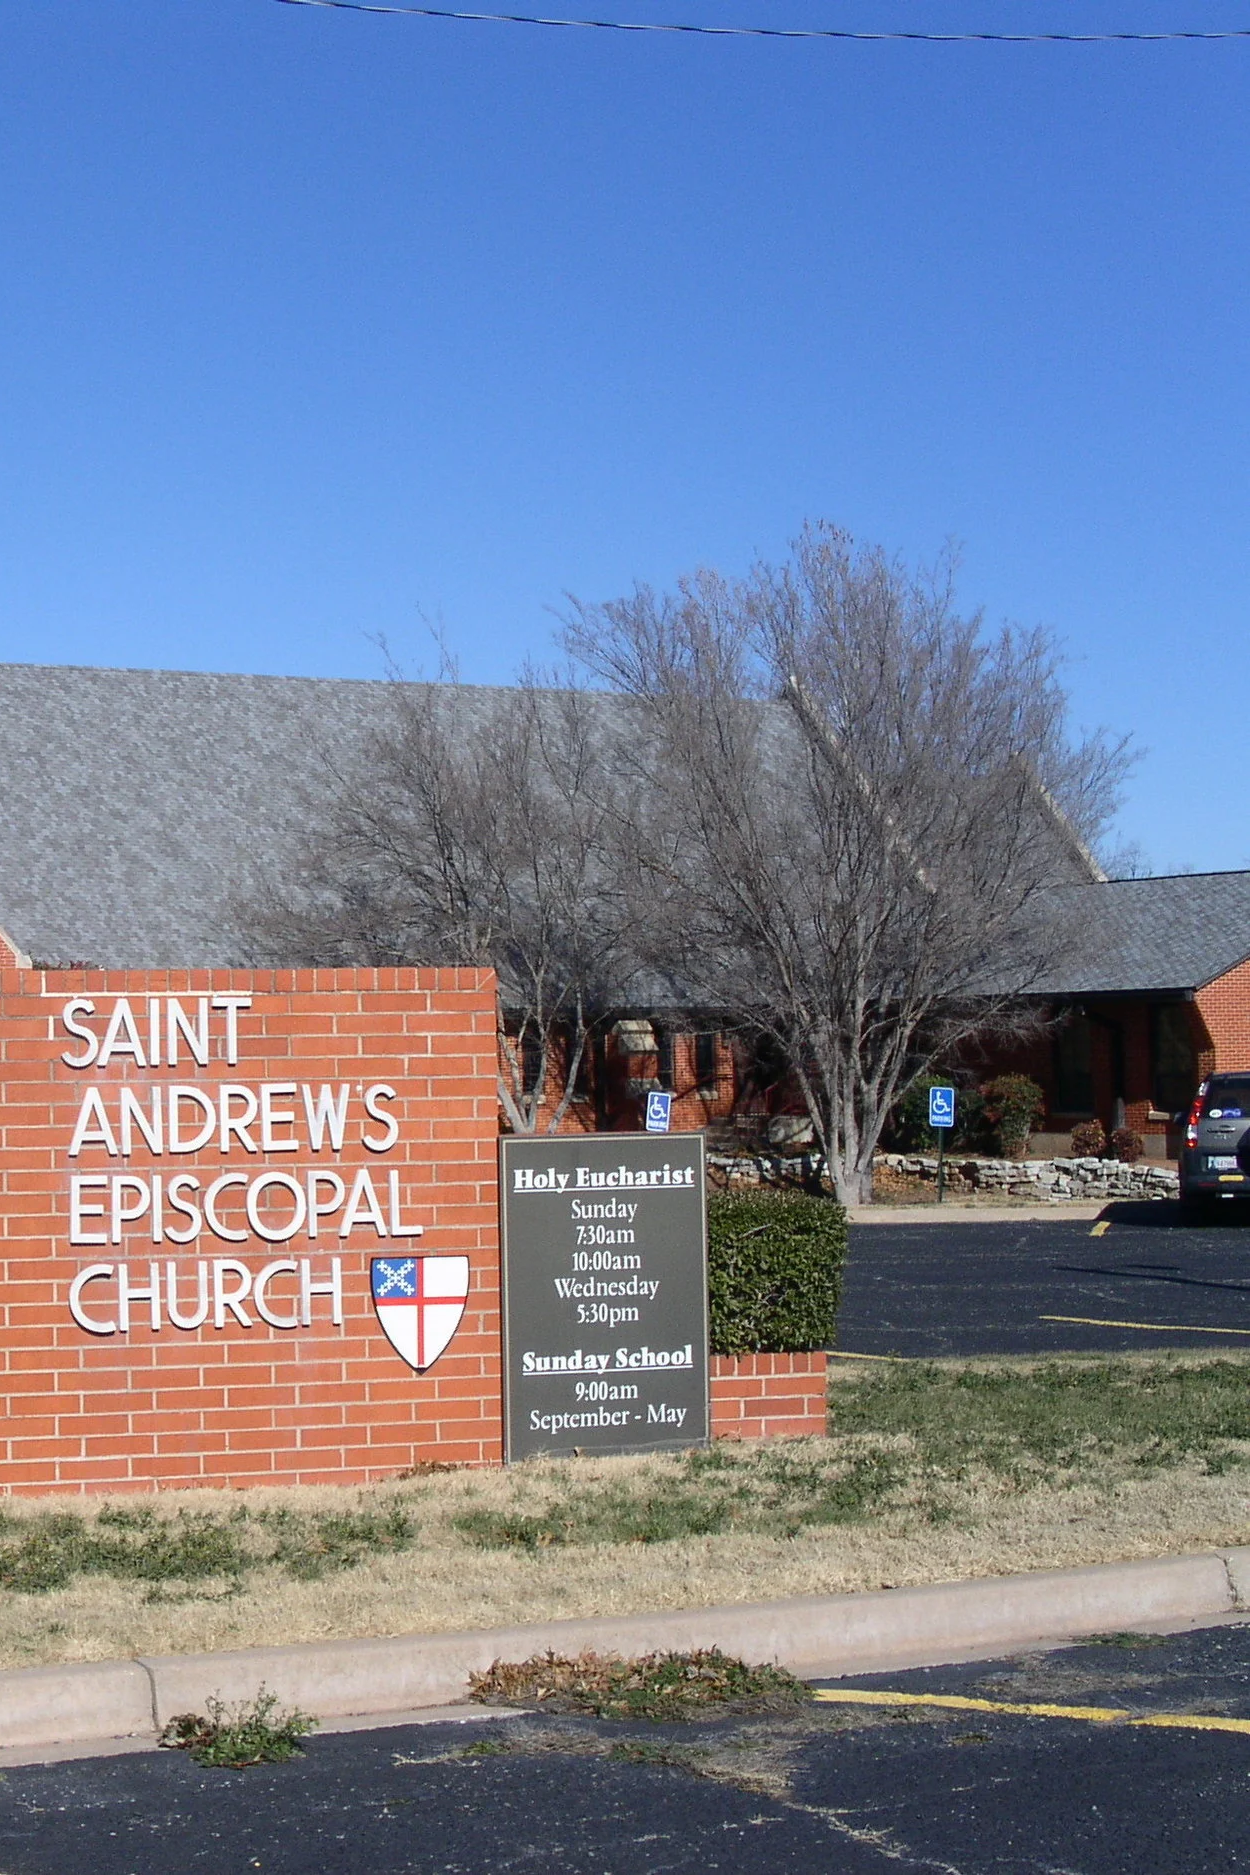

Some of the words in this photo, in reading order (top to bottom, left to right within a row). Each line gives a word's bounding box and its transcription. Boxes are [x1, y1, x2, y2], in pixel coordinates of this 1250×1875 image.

[61, 997, 252, 1068] SAINT
[513, 1168, 570, 1193] Holy
[575, 1164, 695, 1188] Eucharist
[69, 1169, 424, 1245] EPISCOPAL
[571, 1198, 638, 1223] Sunday
[576, 1225, 635, 1245] 7:30am
[571, 1250, 642, 1271] 10:00am
[68, 1257, 343, 1335] CHURCH
[554, 1275, 660, 1300] Wednesday
[576, 1303, 640, 1328] 5:30pm
[522, 1349, 610, 1375] Sunday
[615, 1344, 694, 1369] School
[575, 1381, 639, 1402] 9:00am
[529, 1406, 631, 1435] September
[646, 1403, 688, 1428] May
